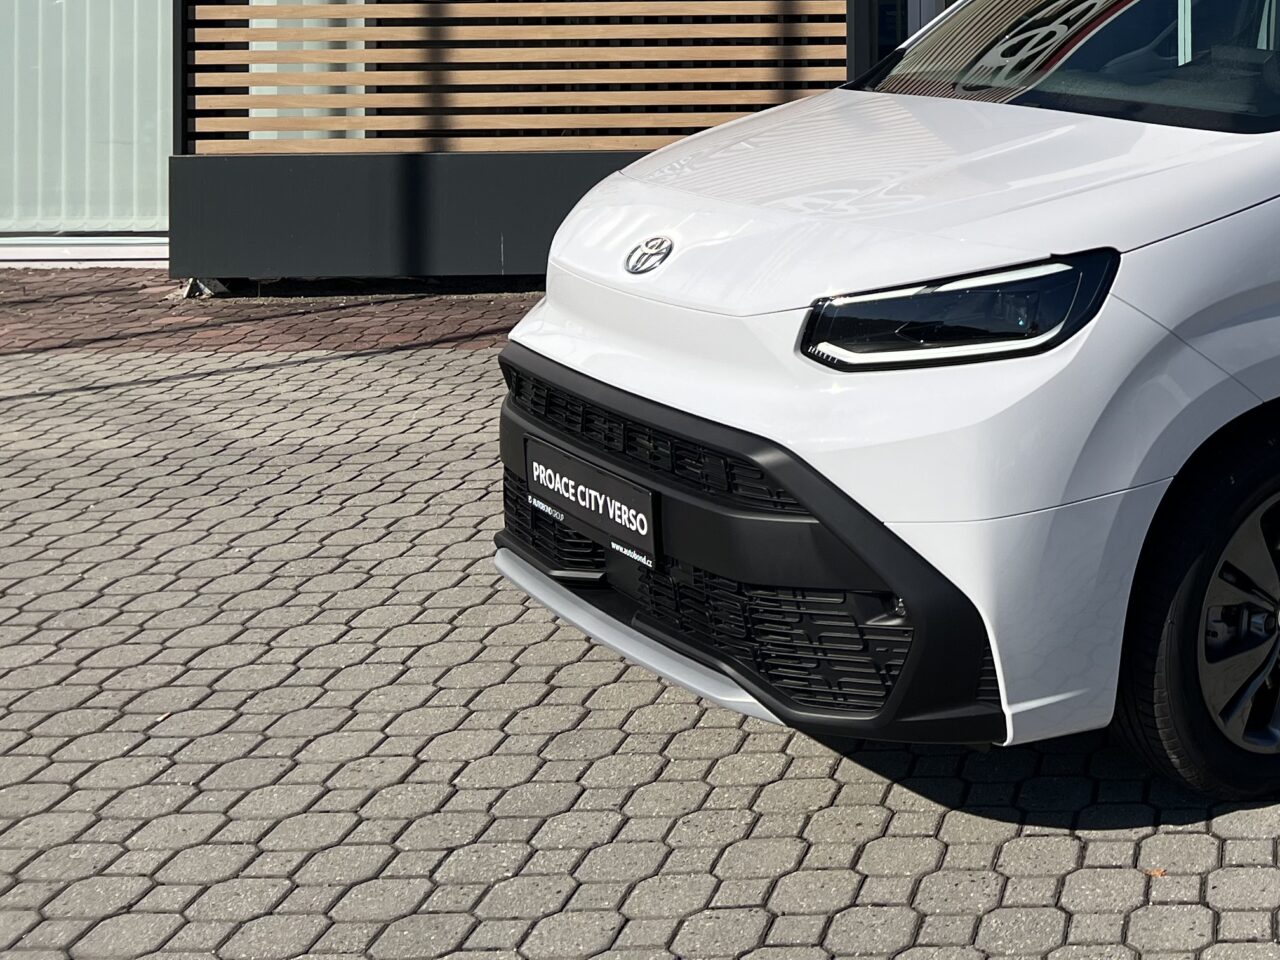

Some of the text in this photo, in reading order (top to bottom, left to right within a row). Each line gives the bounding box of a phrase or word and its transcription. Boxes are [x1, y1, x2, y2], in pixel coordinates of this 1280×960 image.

[532, 461, 648, 536] PROACE CITY VERSO
[610, 541, 653, 568] www.autobond.cz
